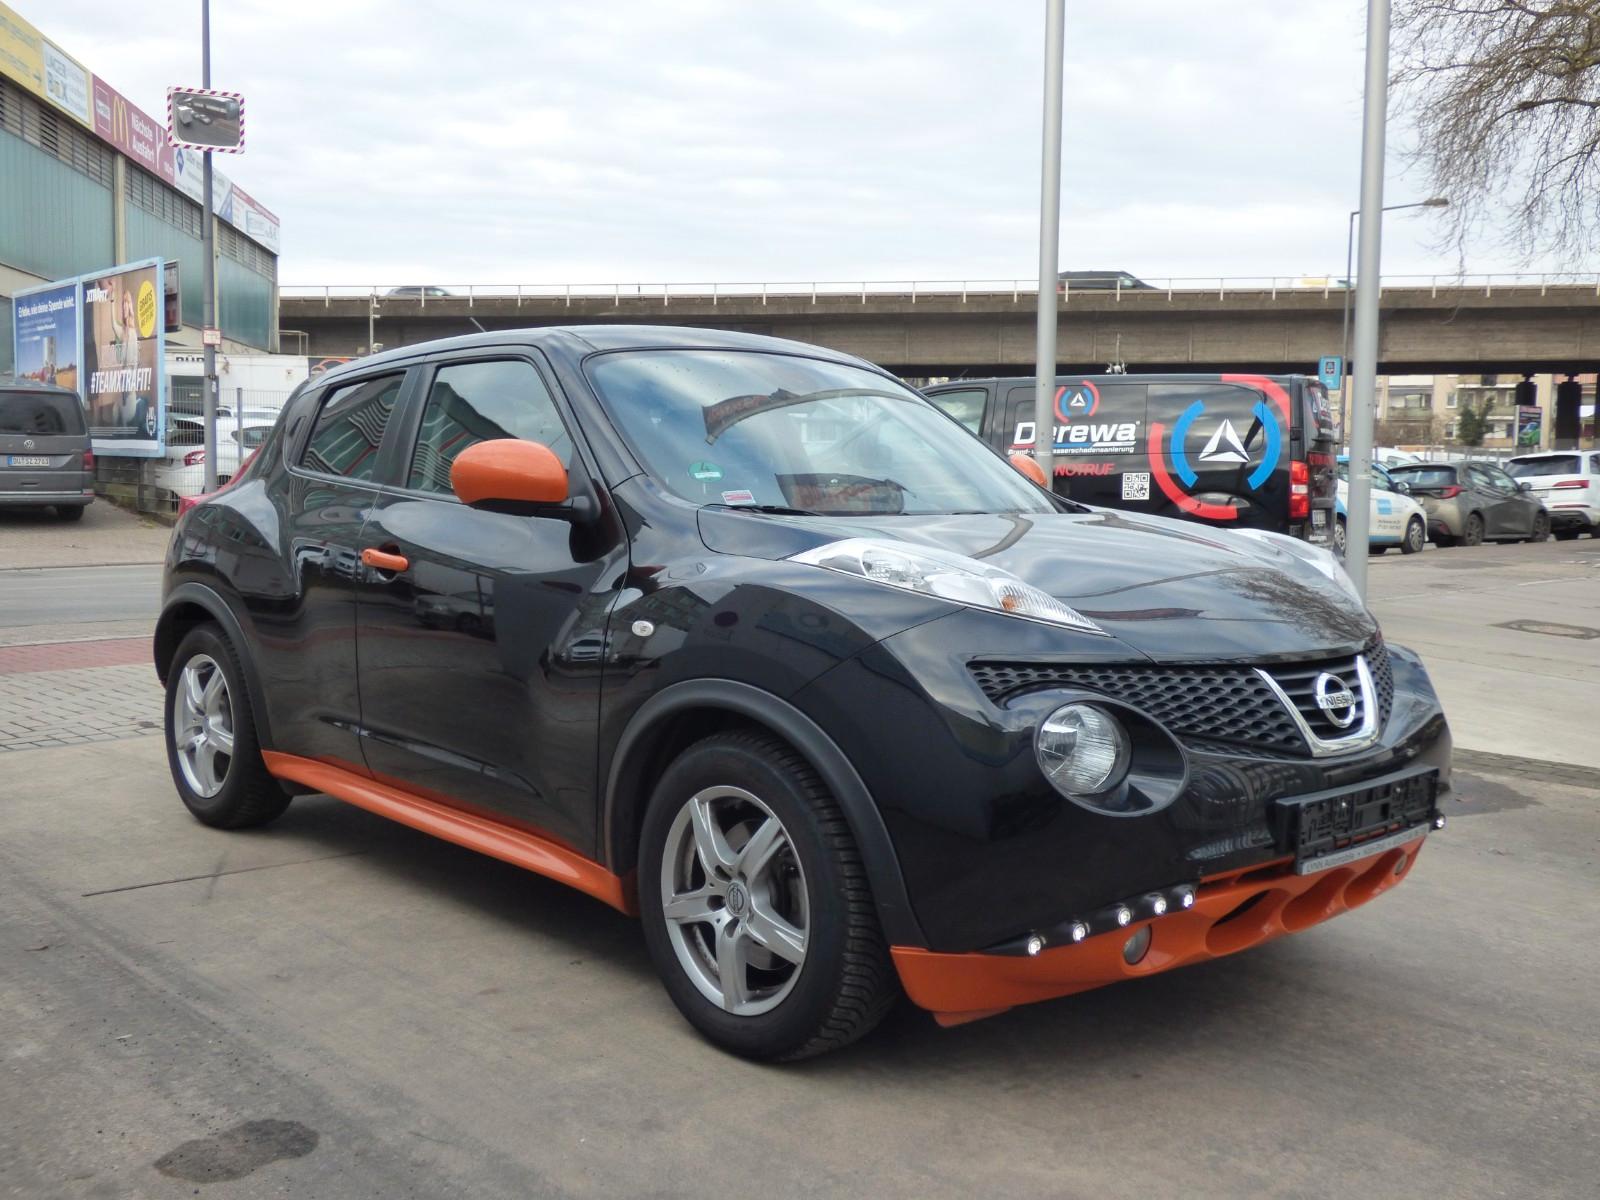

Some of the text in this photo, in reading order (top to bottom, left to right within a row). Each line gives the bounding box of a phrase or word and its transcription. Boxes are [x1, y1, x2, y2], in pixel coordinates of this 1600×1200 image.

[91, 367, 152, 394] #TEAMXTRAFIT!
[1013, 421, 1137, 445] Drewa
[1054, 463, 1116, 476] NOTRUF
